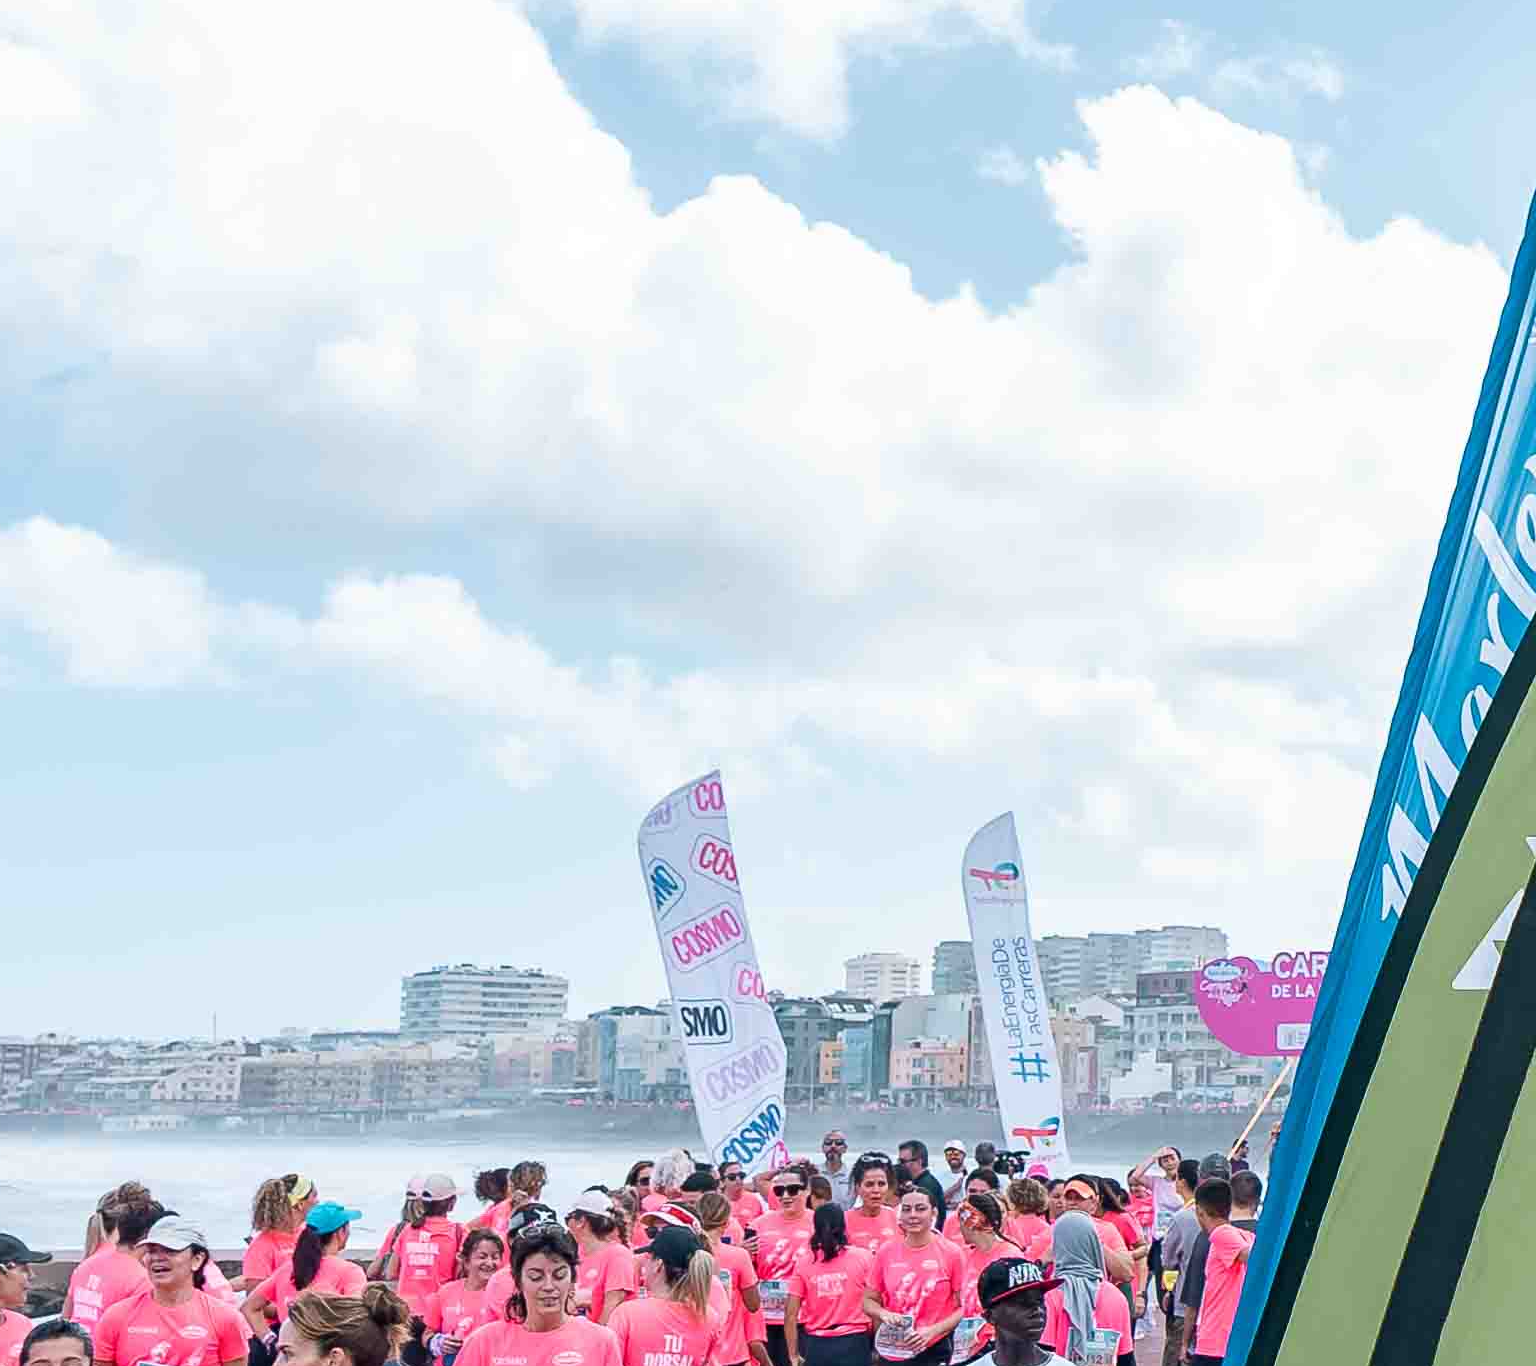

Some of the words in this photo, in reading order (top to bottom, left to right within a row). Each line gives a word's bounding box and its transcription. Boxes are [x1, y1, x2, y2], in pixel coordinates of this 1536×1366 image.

[694, 781, 725, 812] CO
[698, 841, 739, 884] COS
[672, 908, 743, 966] COSMO
[1274, 953, 1329, 979] CAR
[737, 968, 768, 1004] CO
[1272, 984, 1292, 998] DE
[1295, 984, 1315, 998] LA
[681, 1004, 727, 1037] SMO
[705, 1045, 780, 1105] COSMO
[664, 1334, 682, 1354] TU
